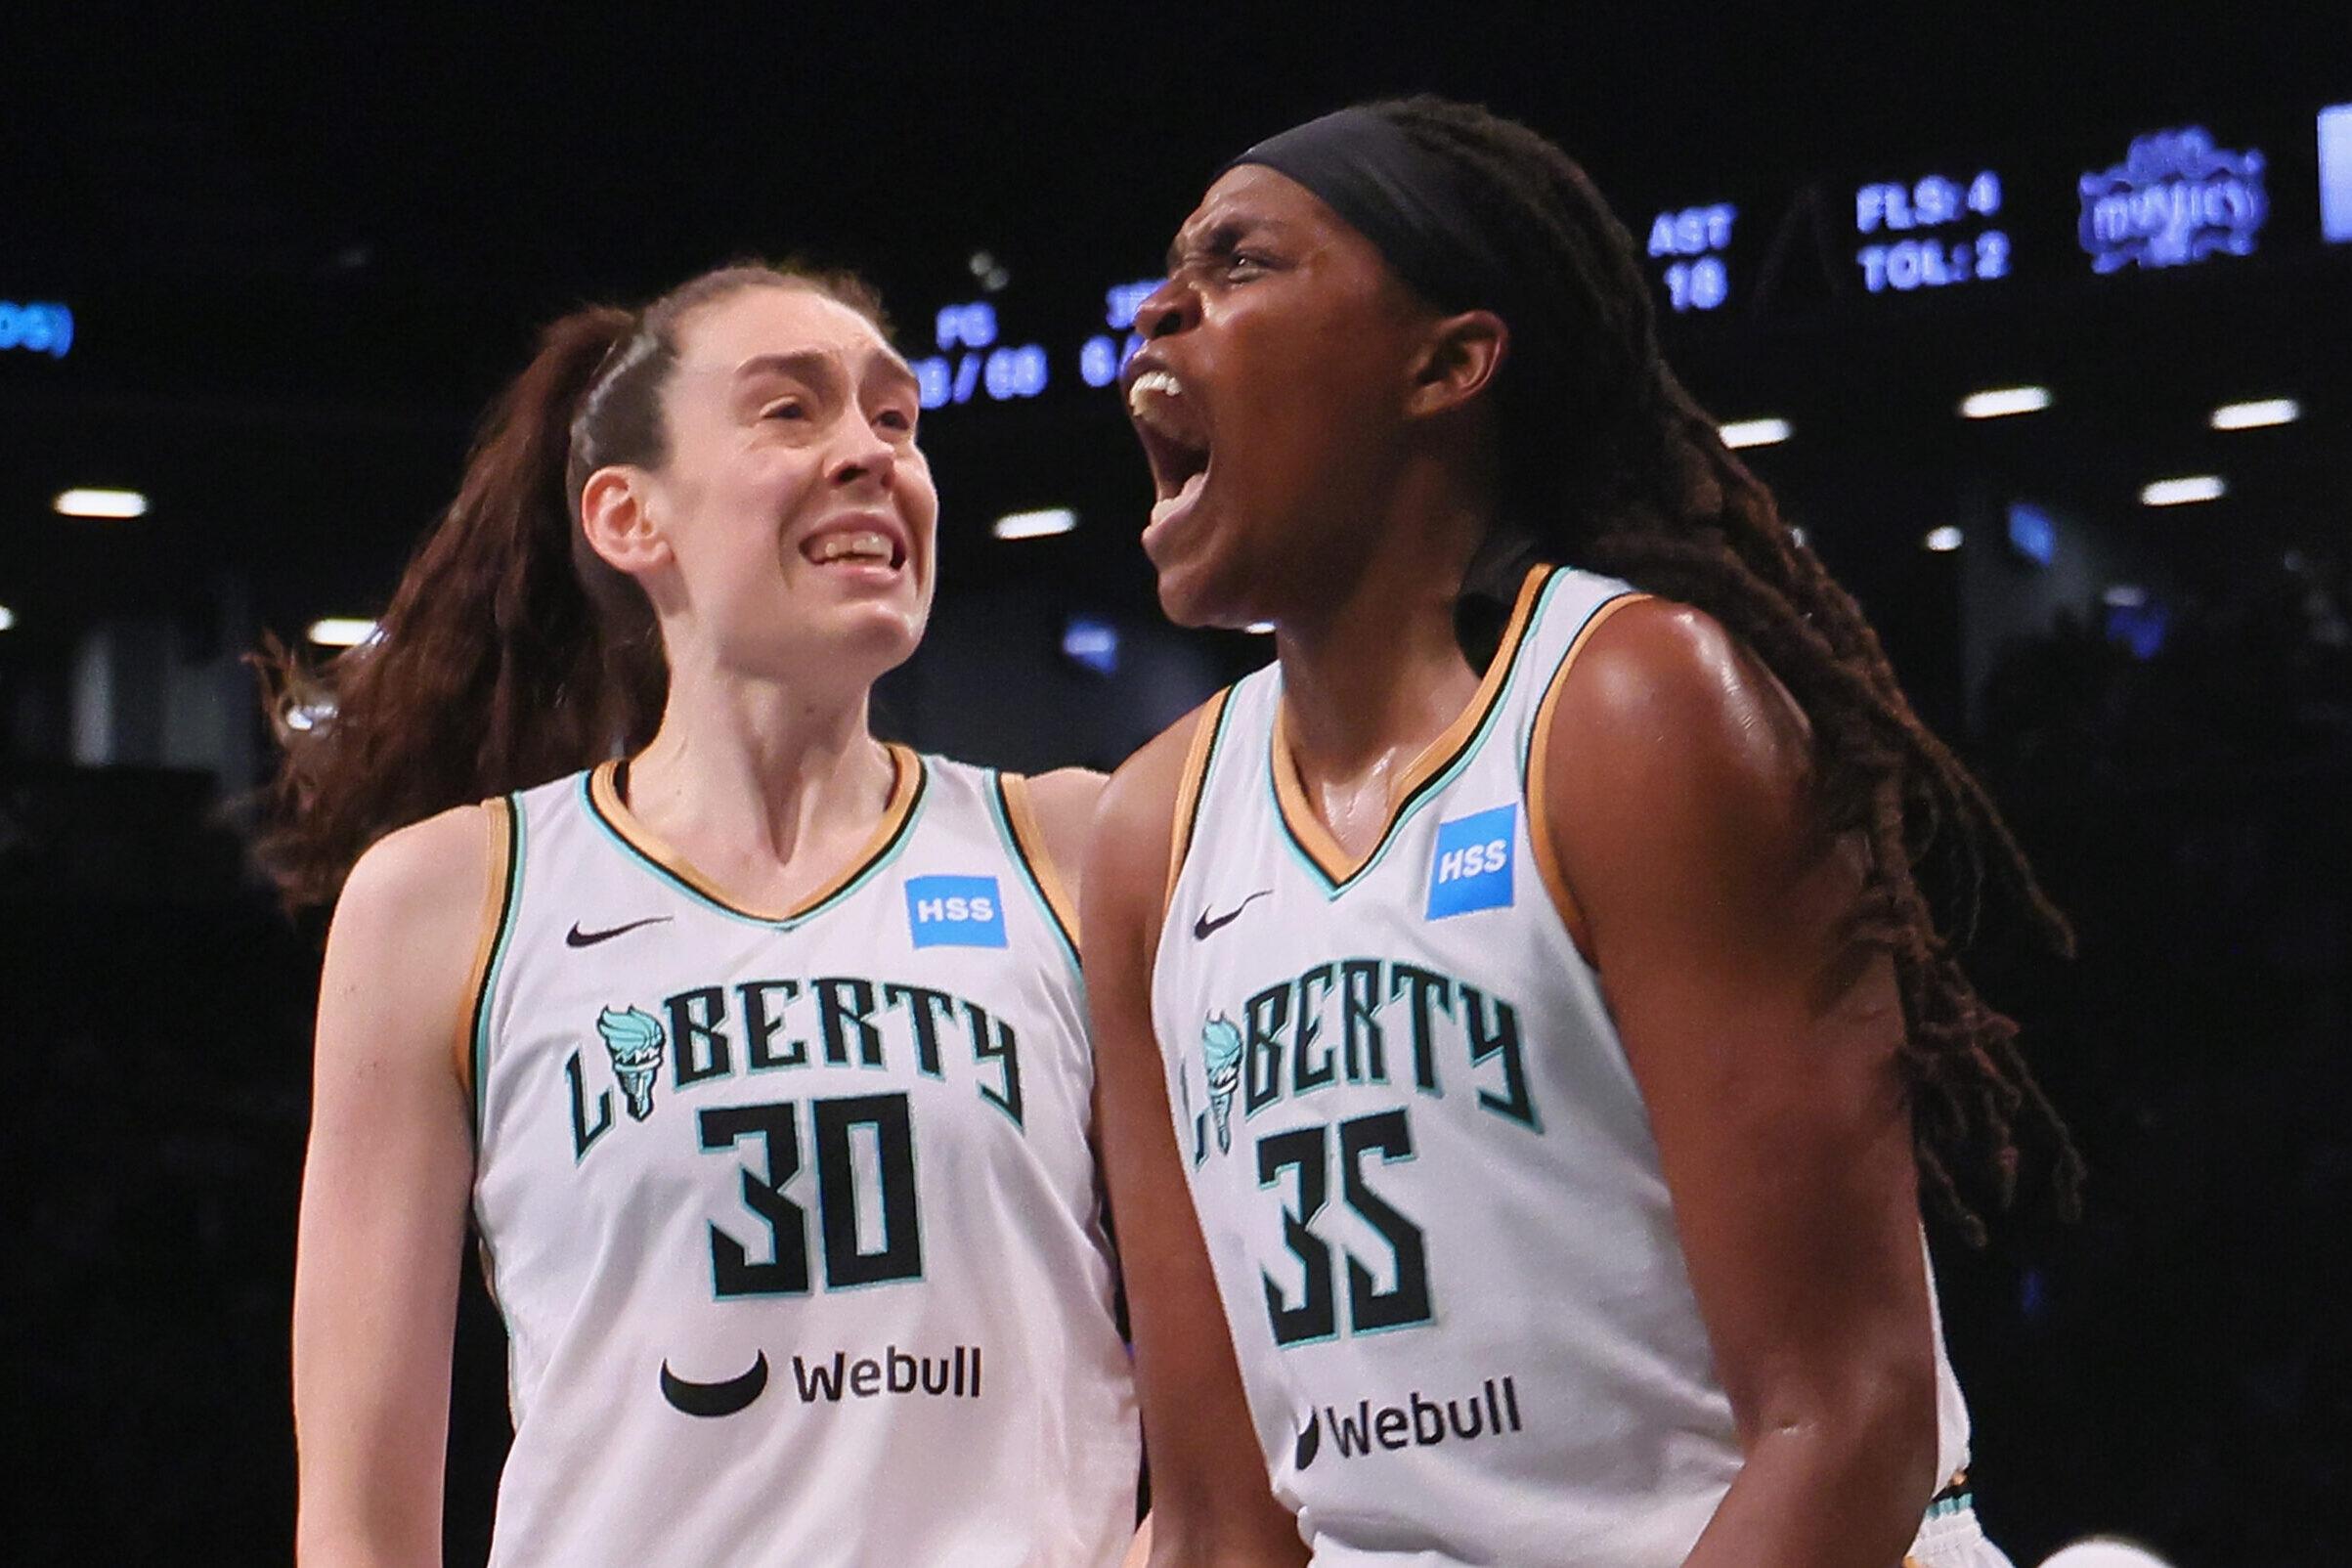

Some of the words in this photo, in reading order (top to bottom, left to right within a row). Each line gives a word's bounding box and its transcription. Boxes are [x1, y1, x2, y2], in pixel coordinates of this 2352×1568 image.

[1647, 203, 1737, 257] AST
[1438, 839, 1507, 885] HSS
[917, 896, 994, 923] HSS
[696, 1091, 925, 1301] 30
[1255, 1105, 1437, 1349] 35
[792, 1345, 981, 1404] Webull
[1327, 1375, 1522, 1459] Webull
